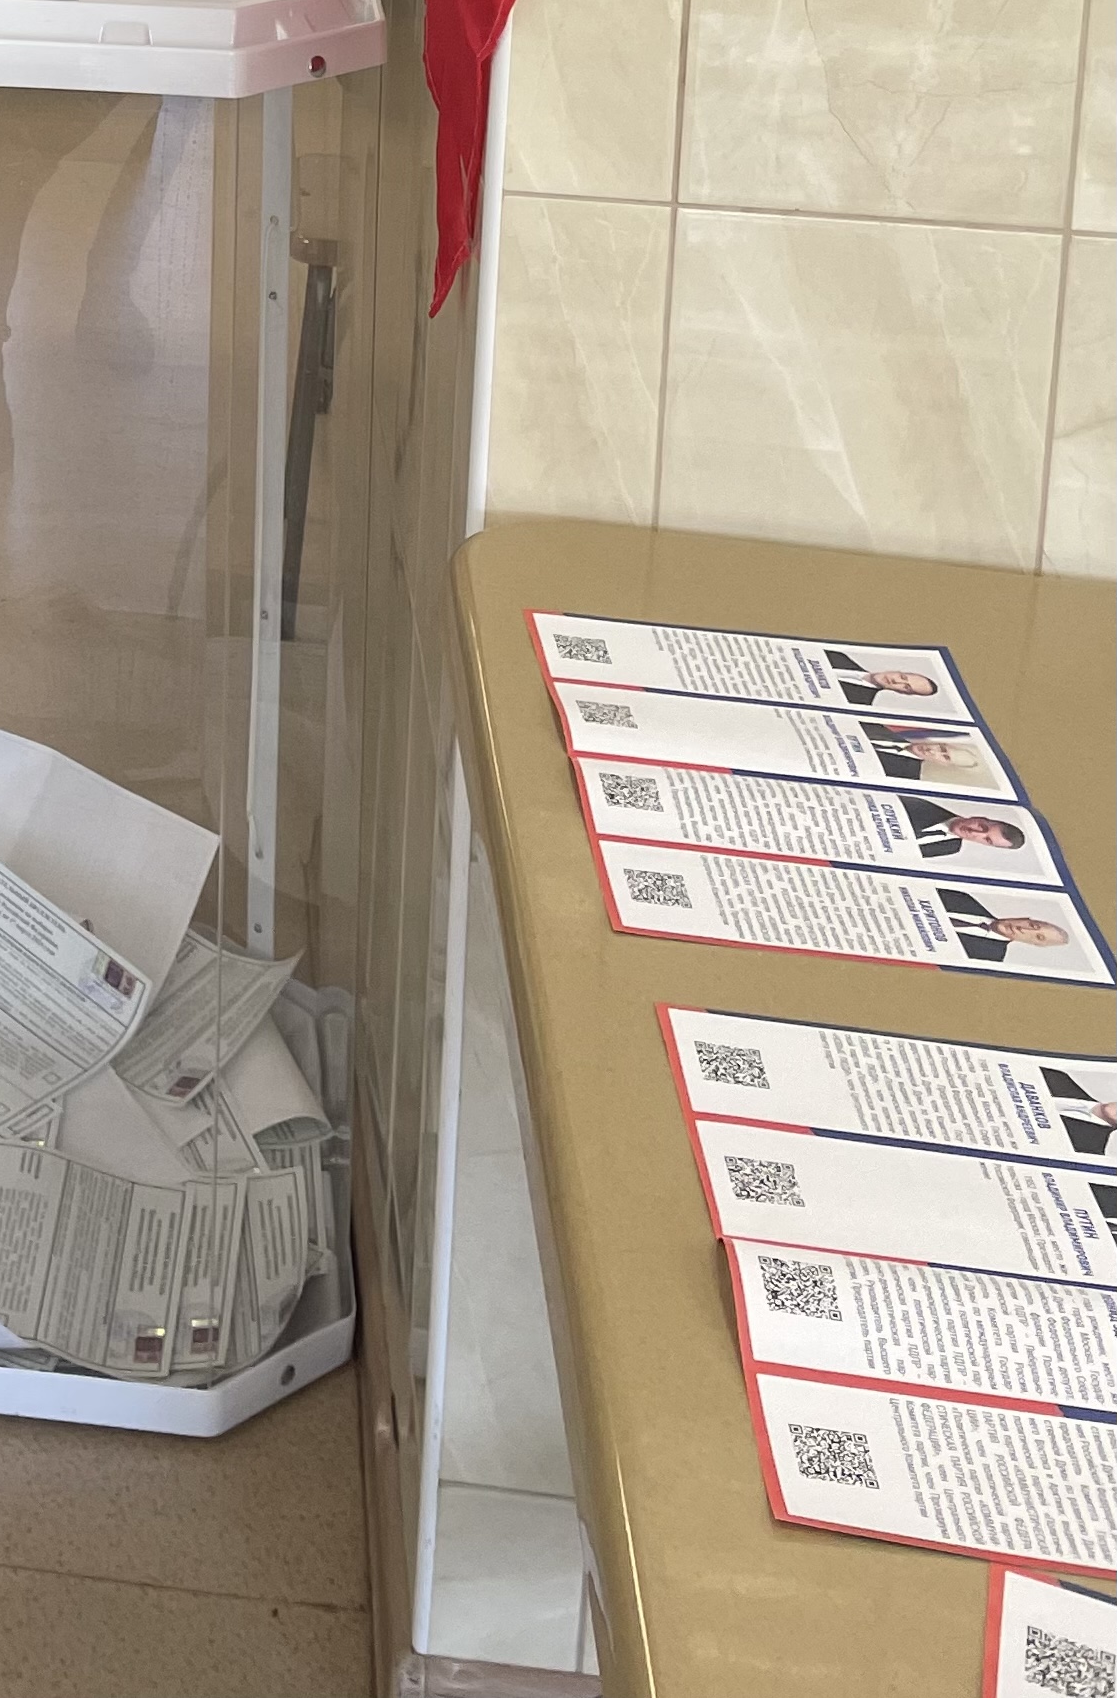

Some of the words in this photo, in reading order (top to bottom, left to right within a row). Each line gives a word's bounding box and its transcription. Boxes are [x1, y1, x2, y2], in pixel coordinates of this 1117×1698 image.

[1017, 1081, 1051, 1129] ДАВАНКОВ
[1041, 1171, 1068, 1211] ВЛАДИМИР
[1058, 1212, 1094, 1276] ВЛАДИМИРОВИЧ
[1072, 1207, 1100, 1239] ПУТИН
[850, 1281, 869, 1337] Председатель
[862, 1339, 875, 1369] партии
[864, 1279, 883, 1333] Руководитель
[877, 1336, 891, 1375] Высшего
[912, 1298, 933, 1355] политической
[958, 1309, 980, 1367] политической
[986, 1307, 1002, 1346] Комитета
[1013, 1303, 1029, 1327] ЛДПР
[907, 1342, 921, 1368] ЛДПР
[952, 1350, 967, 1376] ЛДПР
[975, 1319, 998, 1390] международным
[1060, 1315, 1082, 1373] Федерального
[905, 1399, 921, 1437] Комитета
[981, 1410, 1000, 1443] ПАРТИЯ
[935, 1404, 957, 1451] СТИЧЕСКАЯ
[949, 1455, 968, 1487] ПАРТИЯ
[903, 1452, 920, 1489] Комитета
